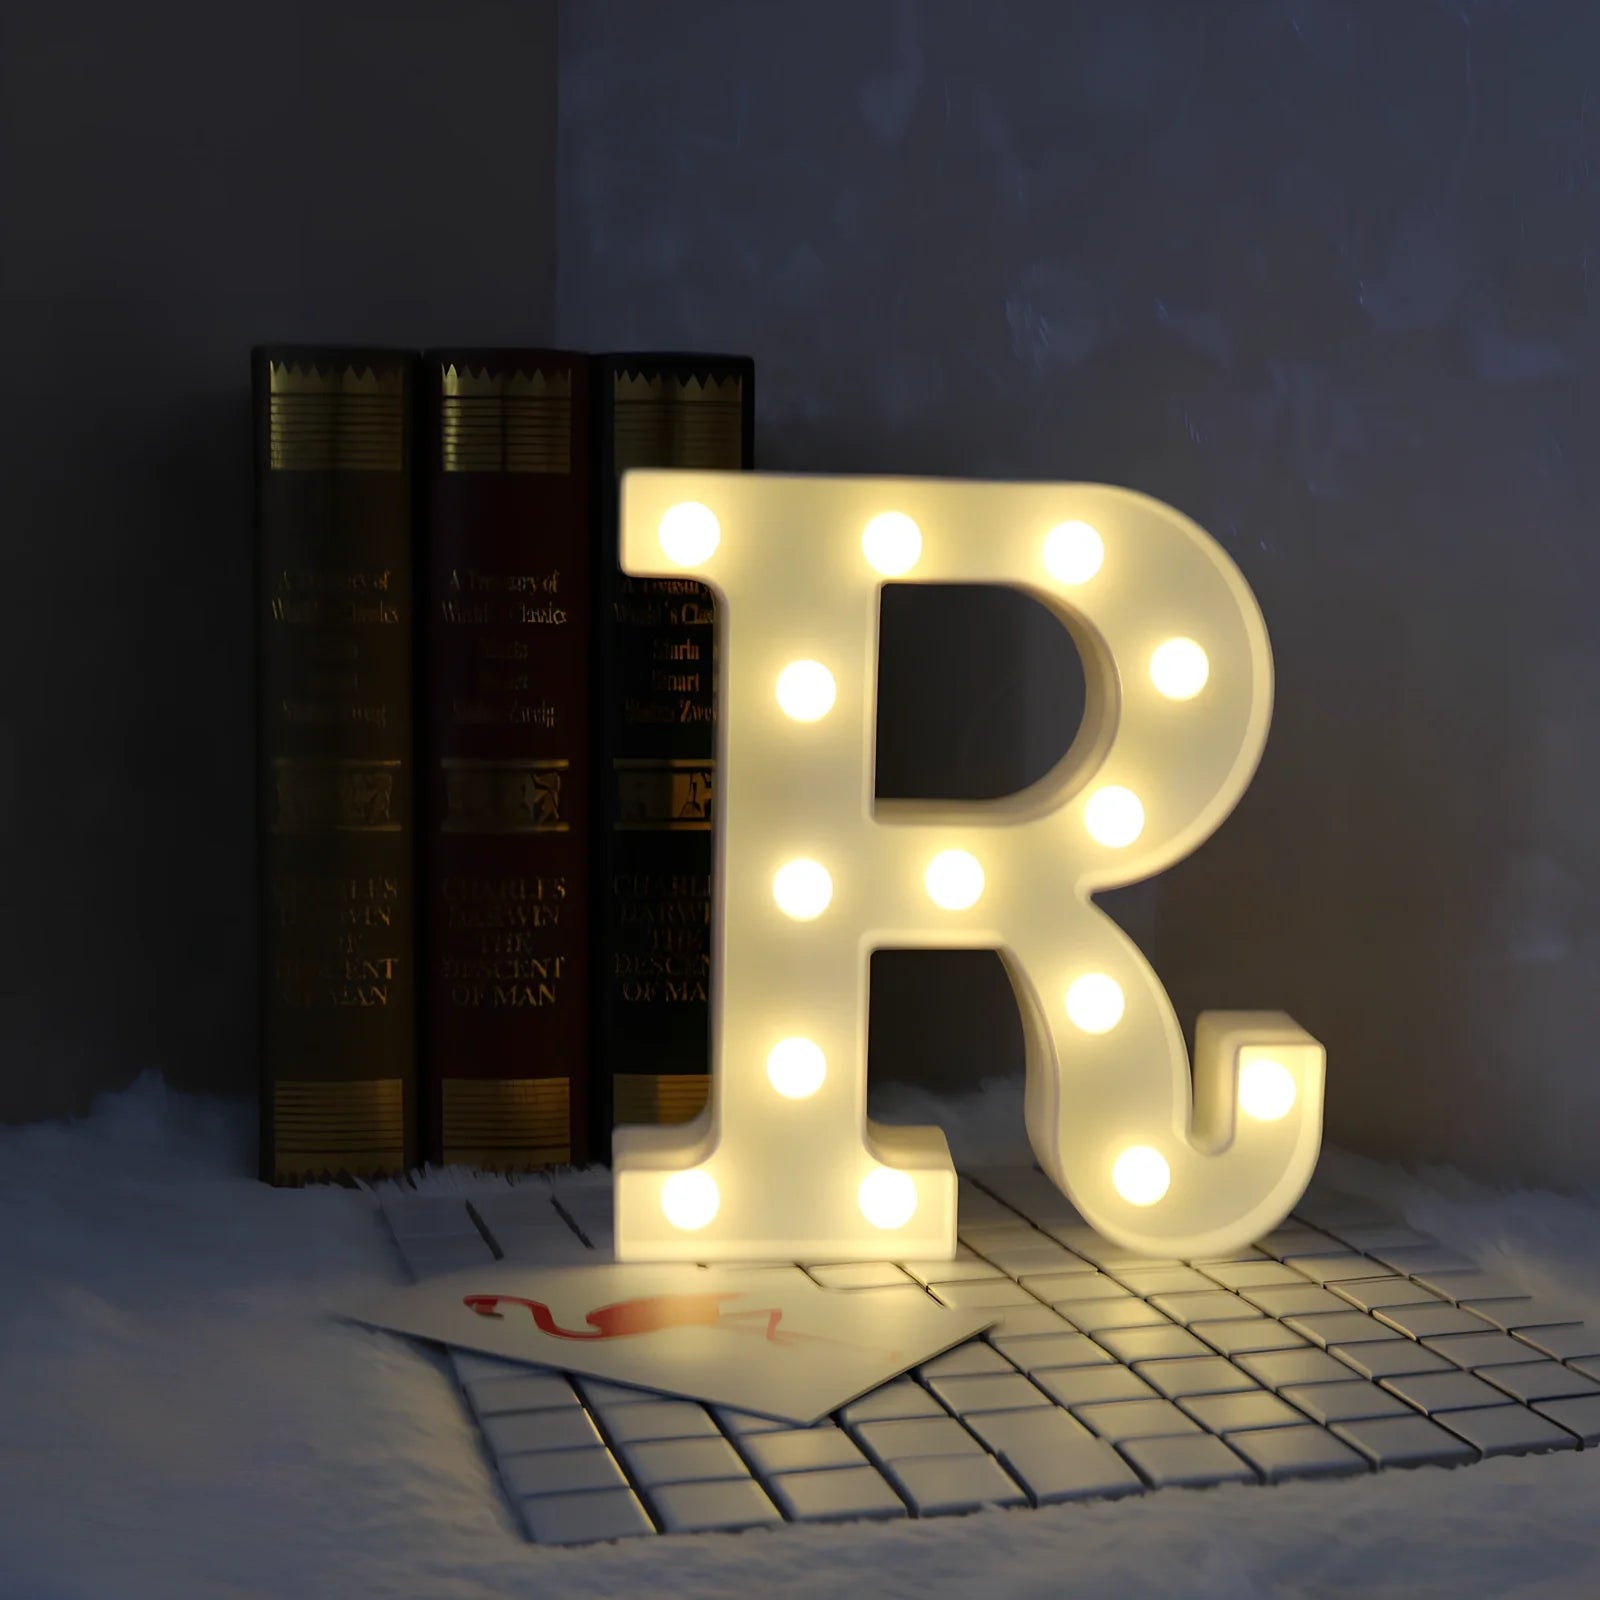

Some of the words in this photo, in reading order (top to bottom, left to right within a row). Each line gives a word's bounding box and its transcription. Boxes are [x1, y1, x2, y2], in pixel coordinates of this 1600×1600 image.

[449, 568, 461, 591] A
[466, 569, 538, 595] Treury
[542, 568, 561, 592] of
[679, 698, 716, 723] Zwe
[612, 468, 1326, 1262] R
[613, 874, 712, 897] CHARL
[621, 901, 711, 926] DARWI
[613, 952, 711, 977] DESCEN
[493, 983, 557, 1008] MAN
[664, 980, 708, 1004] MA
